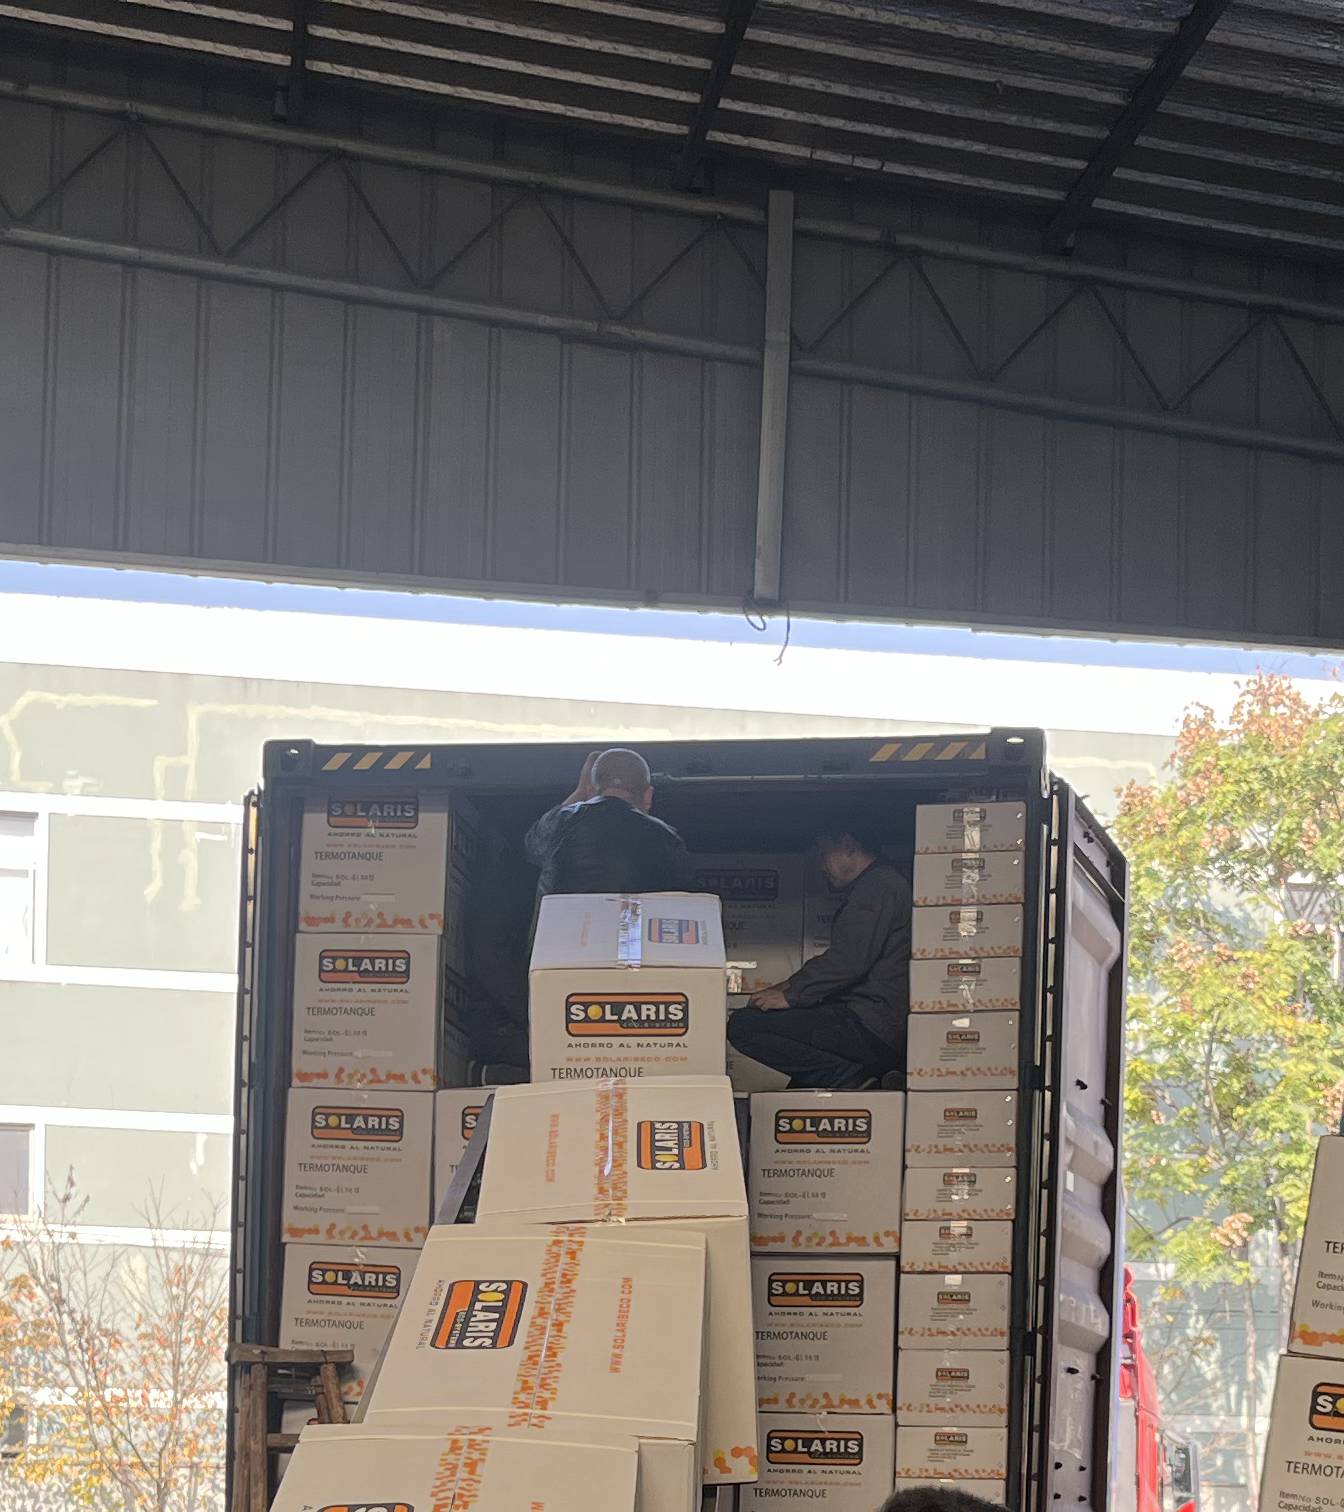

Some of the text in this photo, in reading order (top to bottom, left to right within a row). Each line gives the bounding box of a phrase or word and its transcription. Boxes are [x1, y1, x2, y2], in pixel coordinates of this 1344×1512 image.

[331, 803, 415, 817] SOLARIS
[314, 851, 384, 861] TERMOTANQUE
[322, 958, 406, 971] SOLARIS
[306, 1007, 376, 1016] TERMOTANQUE
[570, 1005, 683, 1020] SOLARIS
[314, 1115, 400, 1130] SOLARIS
[778, 1118, 868, 1132] SOLARIS
[655, 1122, 679, 1169] SOLARIS
[298, 1163, 368, 1174] TERMOTANQUE
[761, 1168, 835, 1178] TERMOTANQUE
[312, 1270, 397, 1287] SOLARIS
[771, 1282, 860, 1295] SOLARIS
[463, 1282, 507, 1348] SOLARIS
[294, 1318, 364, 1330] TERMOTANQUE
[756, 1331, 828, 1341] TERMOTANQUE
[770, 1438, 859, 1453] SOLARIS
[753, 1488, 827, 1498] TERMOTANQUE
